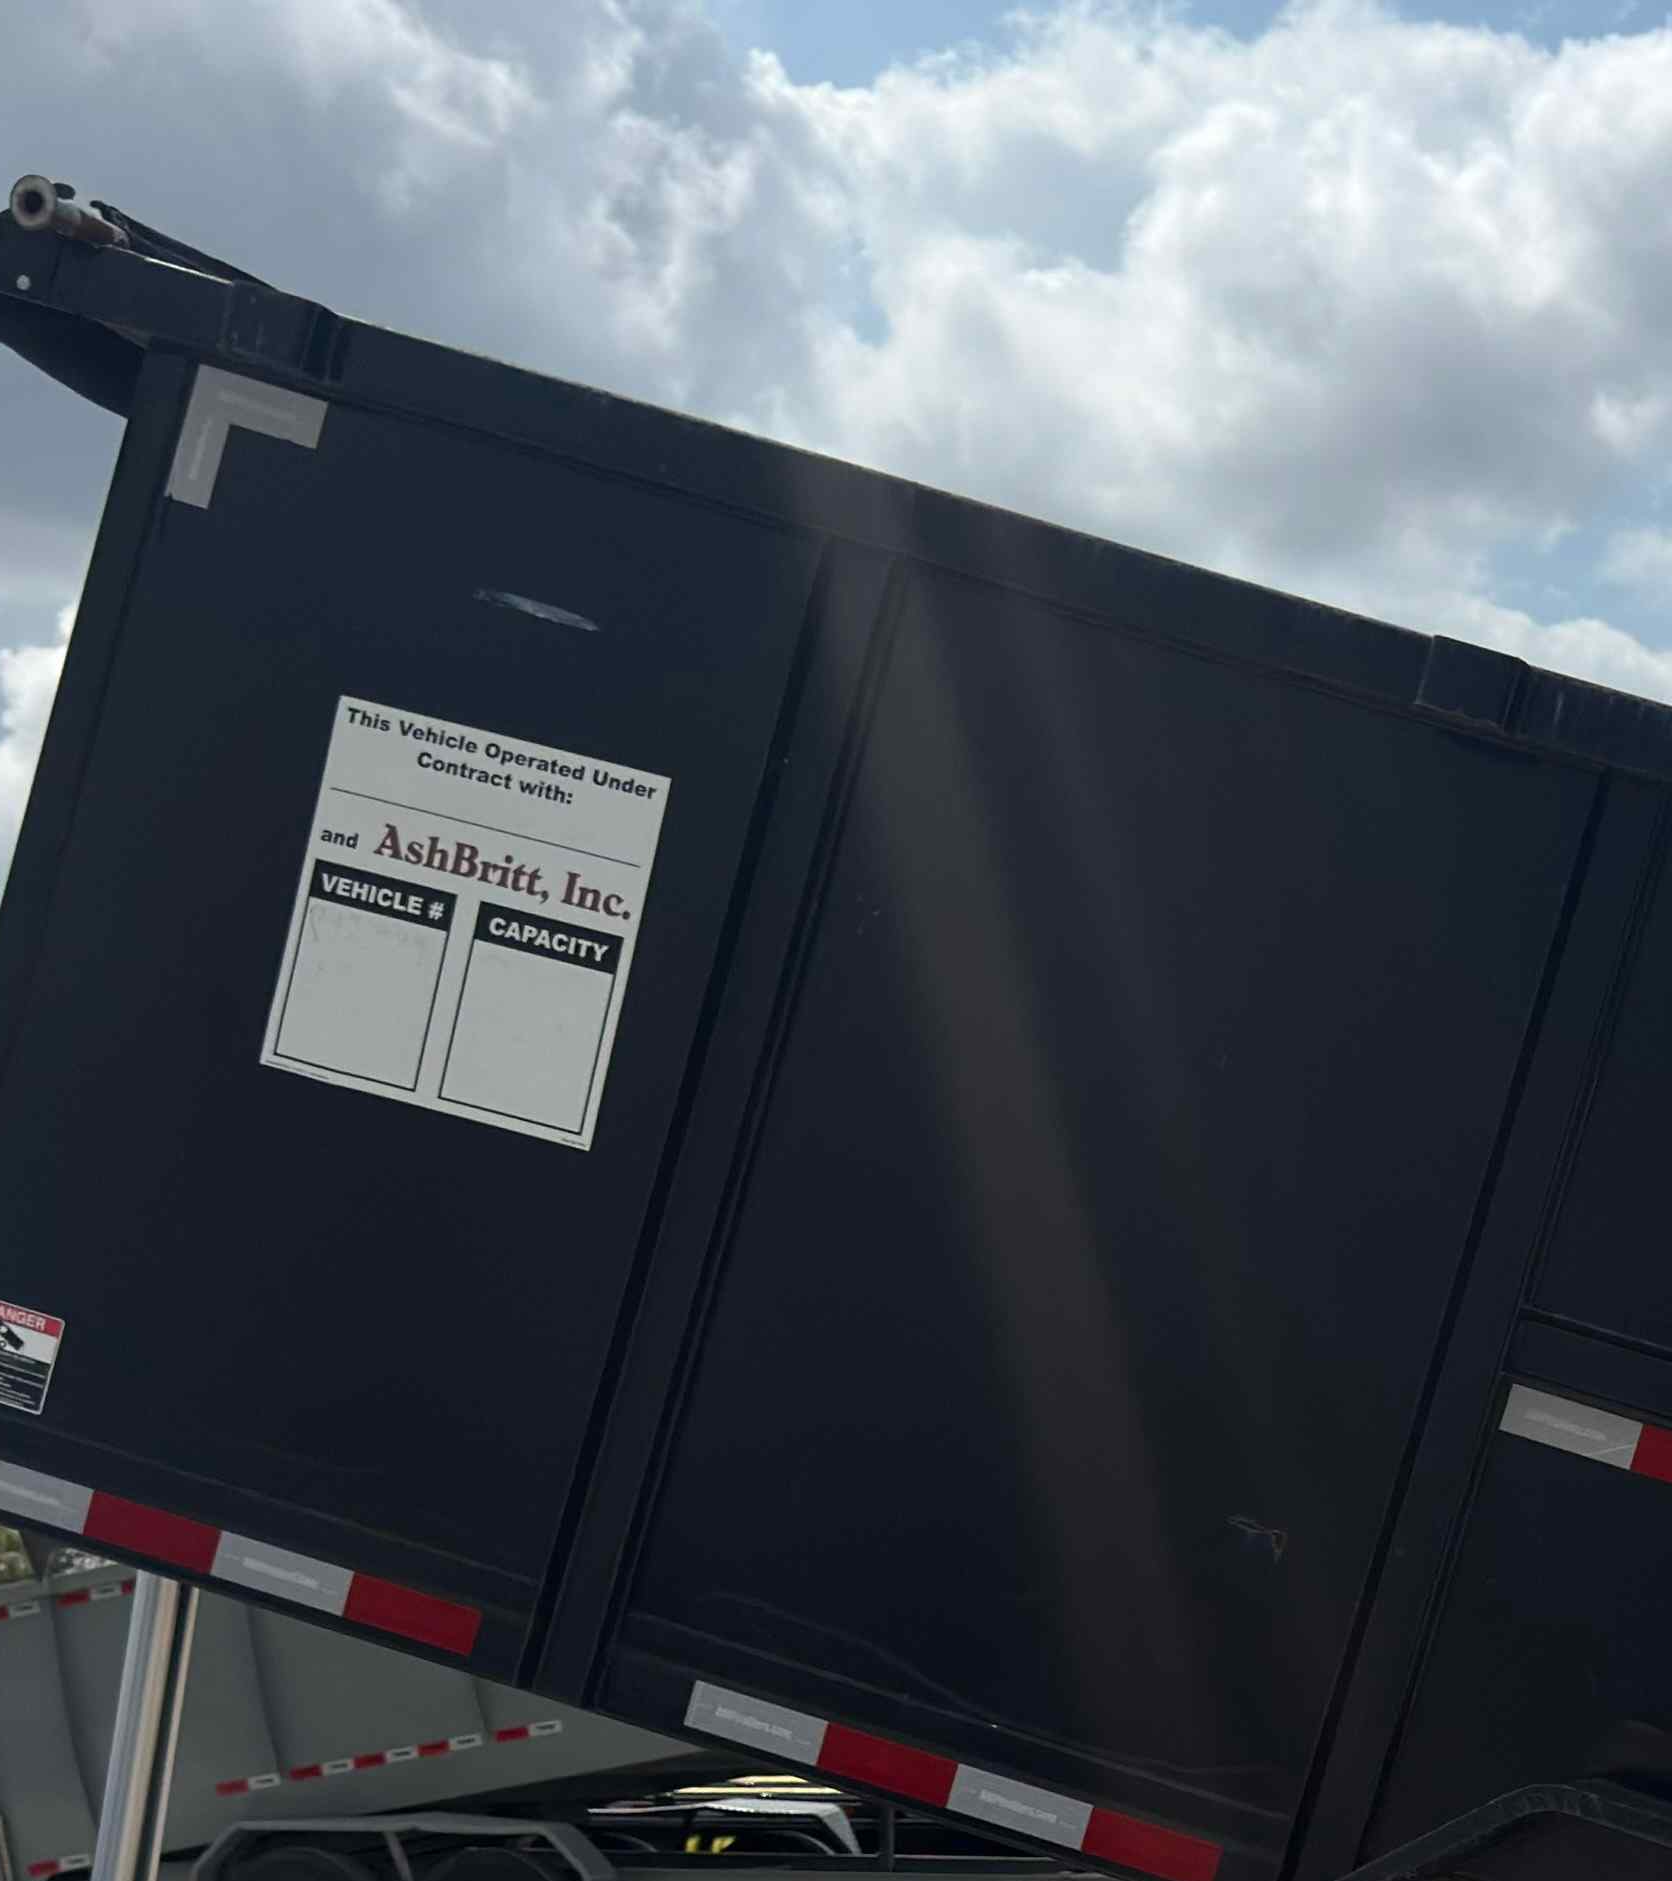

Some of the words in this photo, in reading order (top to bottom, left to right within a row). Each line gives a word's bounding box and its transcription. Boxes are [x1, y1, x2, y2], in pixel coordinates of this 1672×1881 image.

[346, 707, 391, 732] This
[400, 719, 478, 754] Vehicle
[485, 743, 586, 782] Operated
[592, 769, 657, 800] Under
[417, 752, 512, 790] Contract
[519, 778, 574, 805] with:
[320, 828, 359, 849] and
[374, 824, 550, 904] AshBritt,
[561, 871, 632, 920] Inc.
[321, 873, 423, 916] VEHICLE
[428, 900, 446, 921] #
[488, 916, 609, 963] CAPACITY
